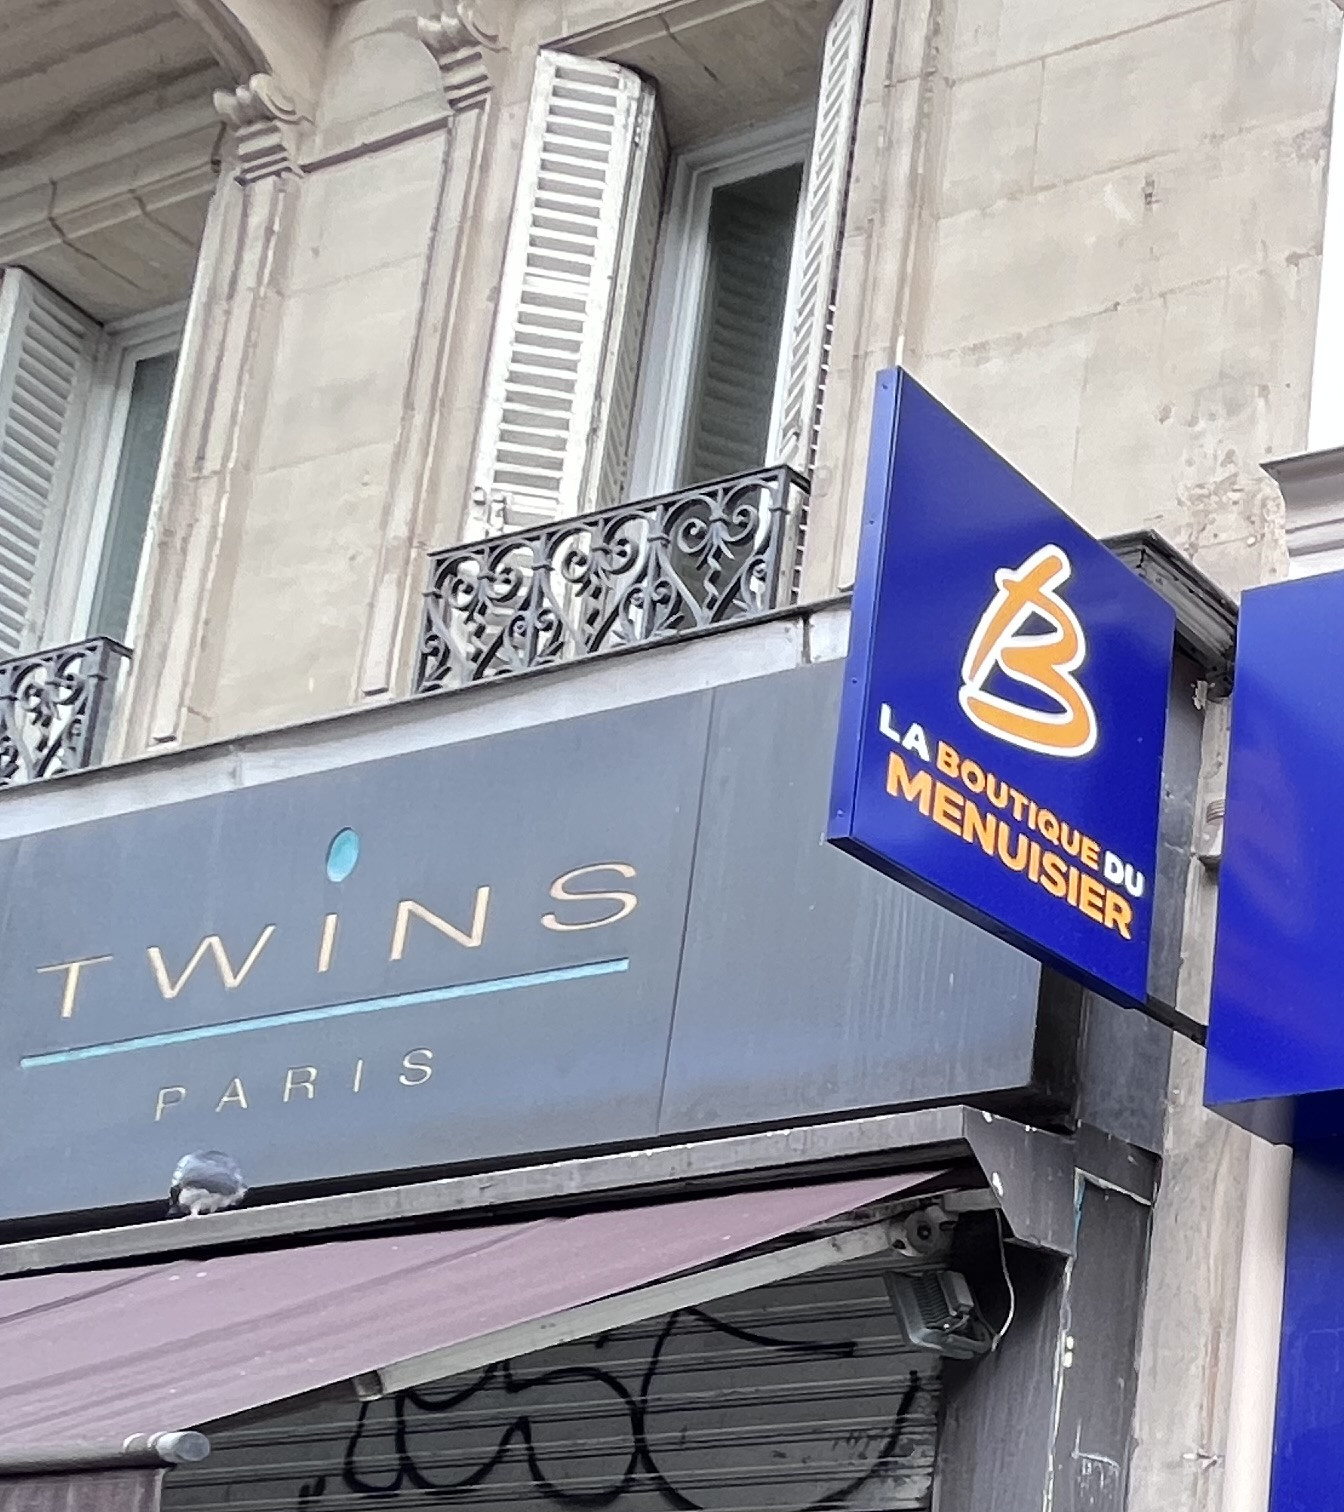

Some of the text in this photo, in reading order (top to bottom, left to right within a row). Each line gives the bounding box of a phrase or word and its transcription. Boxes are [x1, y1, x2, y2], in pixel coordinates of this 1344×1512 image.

[959, 543, 1098, 757] B
[878, 702, 1146, 898] LA BOUTIQUE DU
[885, 750, 1135, 941] MENUISIER
[36, 860, 639, 1019] TWINS
[153, 1047, 436, 1123] PARIS
